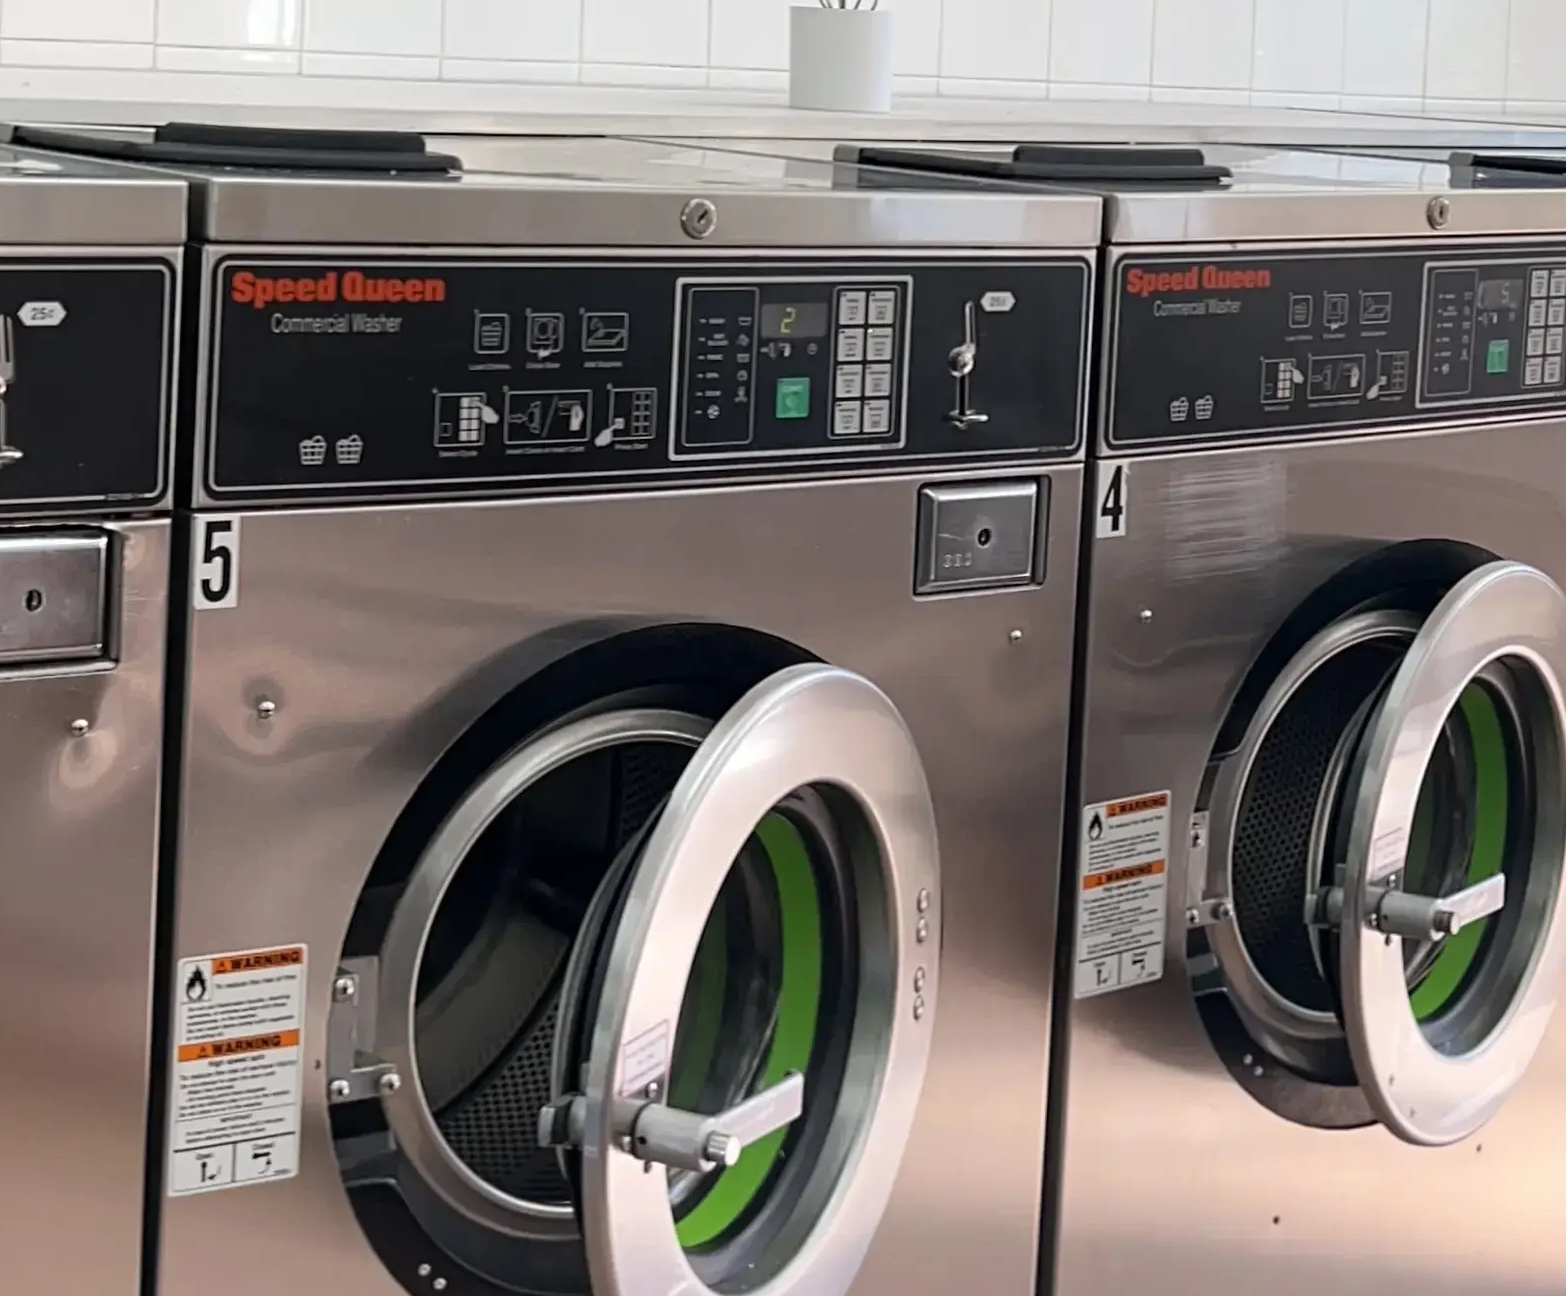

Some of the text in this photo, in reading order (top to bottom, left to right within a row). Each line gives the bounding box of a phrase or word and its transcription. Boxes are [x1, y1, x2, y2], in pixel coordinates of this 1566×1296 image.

[231, 271, 446, 308] Speed Queen
[1126, 266, 1271, 298] Speed Queen
[271, 313, 402, 333] Commercial Washer
[781, 307, 796, 333] 2
[1101, 466, 1123, 531] 4
[201, 520, 232, 602] 5
[231, 951, 300, 970] WARNING
[213, 1035, 281, 1055] WARNING
